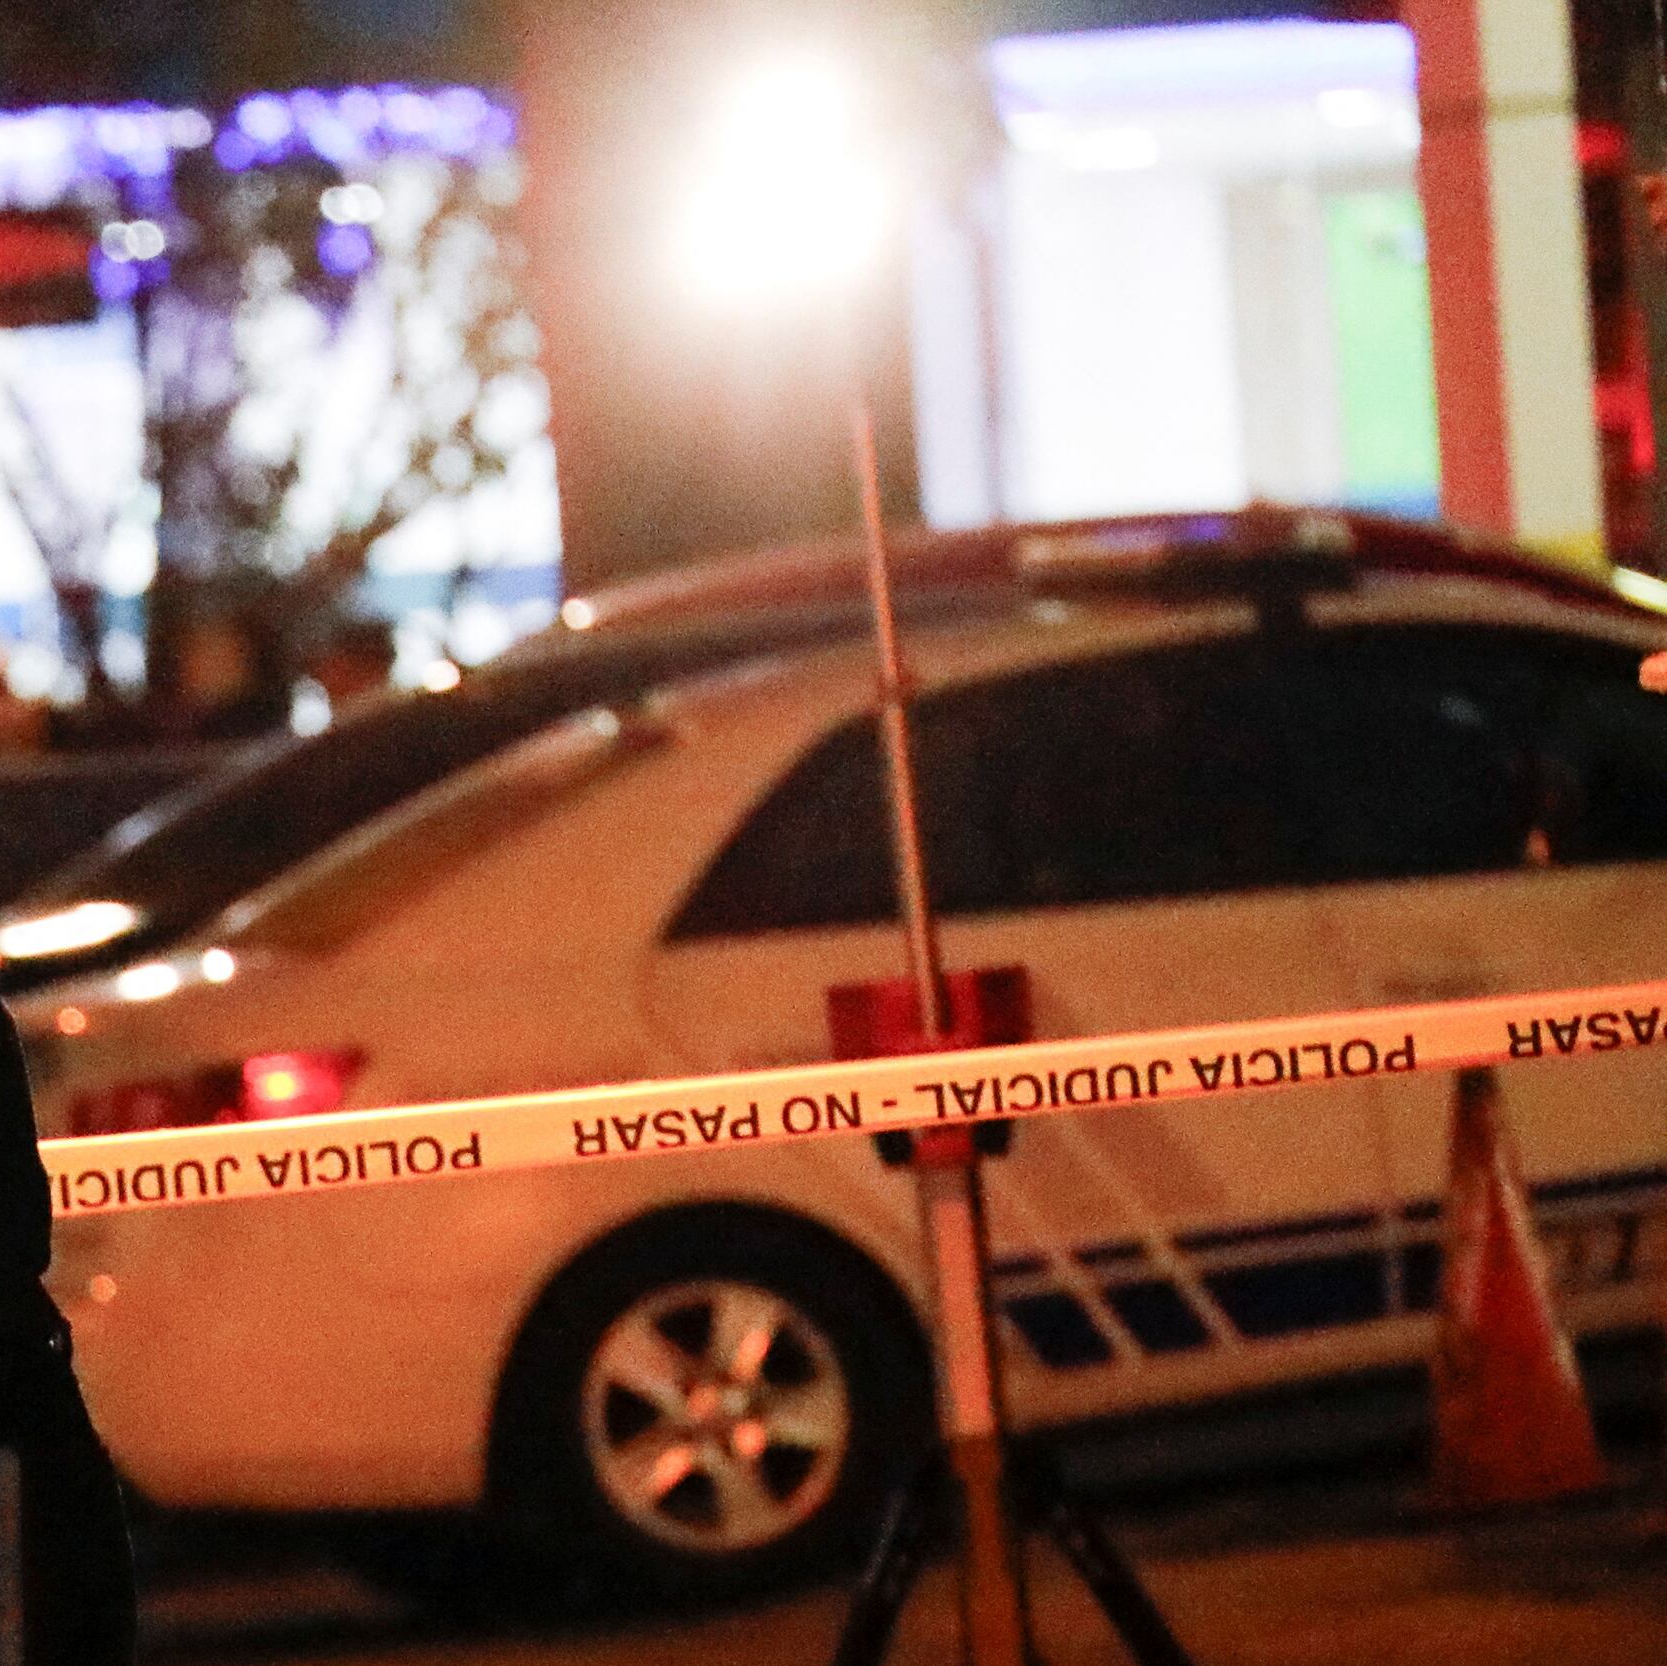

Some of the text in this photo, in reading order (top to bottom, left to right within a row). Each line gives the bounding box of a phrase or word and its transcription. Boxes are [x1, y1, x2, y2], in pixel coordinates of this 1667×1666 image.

[1507, 1005, 1667, 1058] ASAR
[1193, 1033, 1416, 1089] POLICIA
[782, 1092, 863, 1133] NO
[914, 1059, 1176, 1117] JUDICIAL
[573, 1103, 761, 1155] PASAR
[49, 1156, 239, 1209] JUDICI
[257, 1133, 482, 1187] POLICIA
